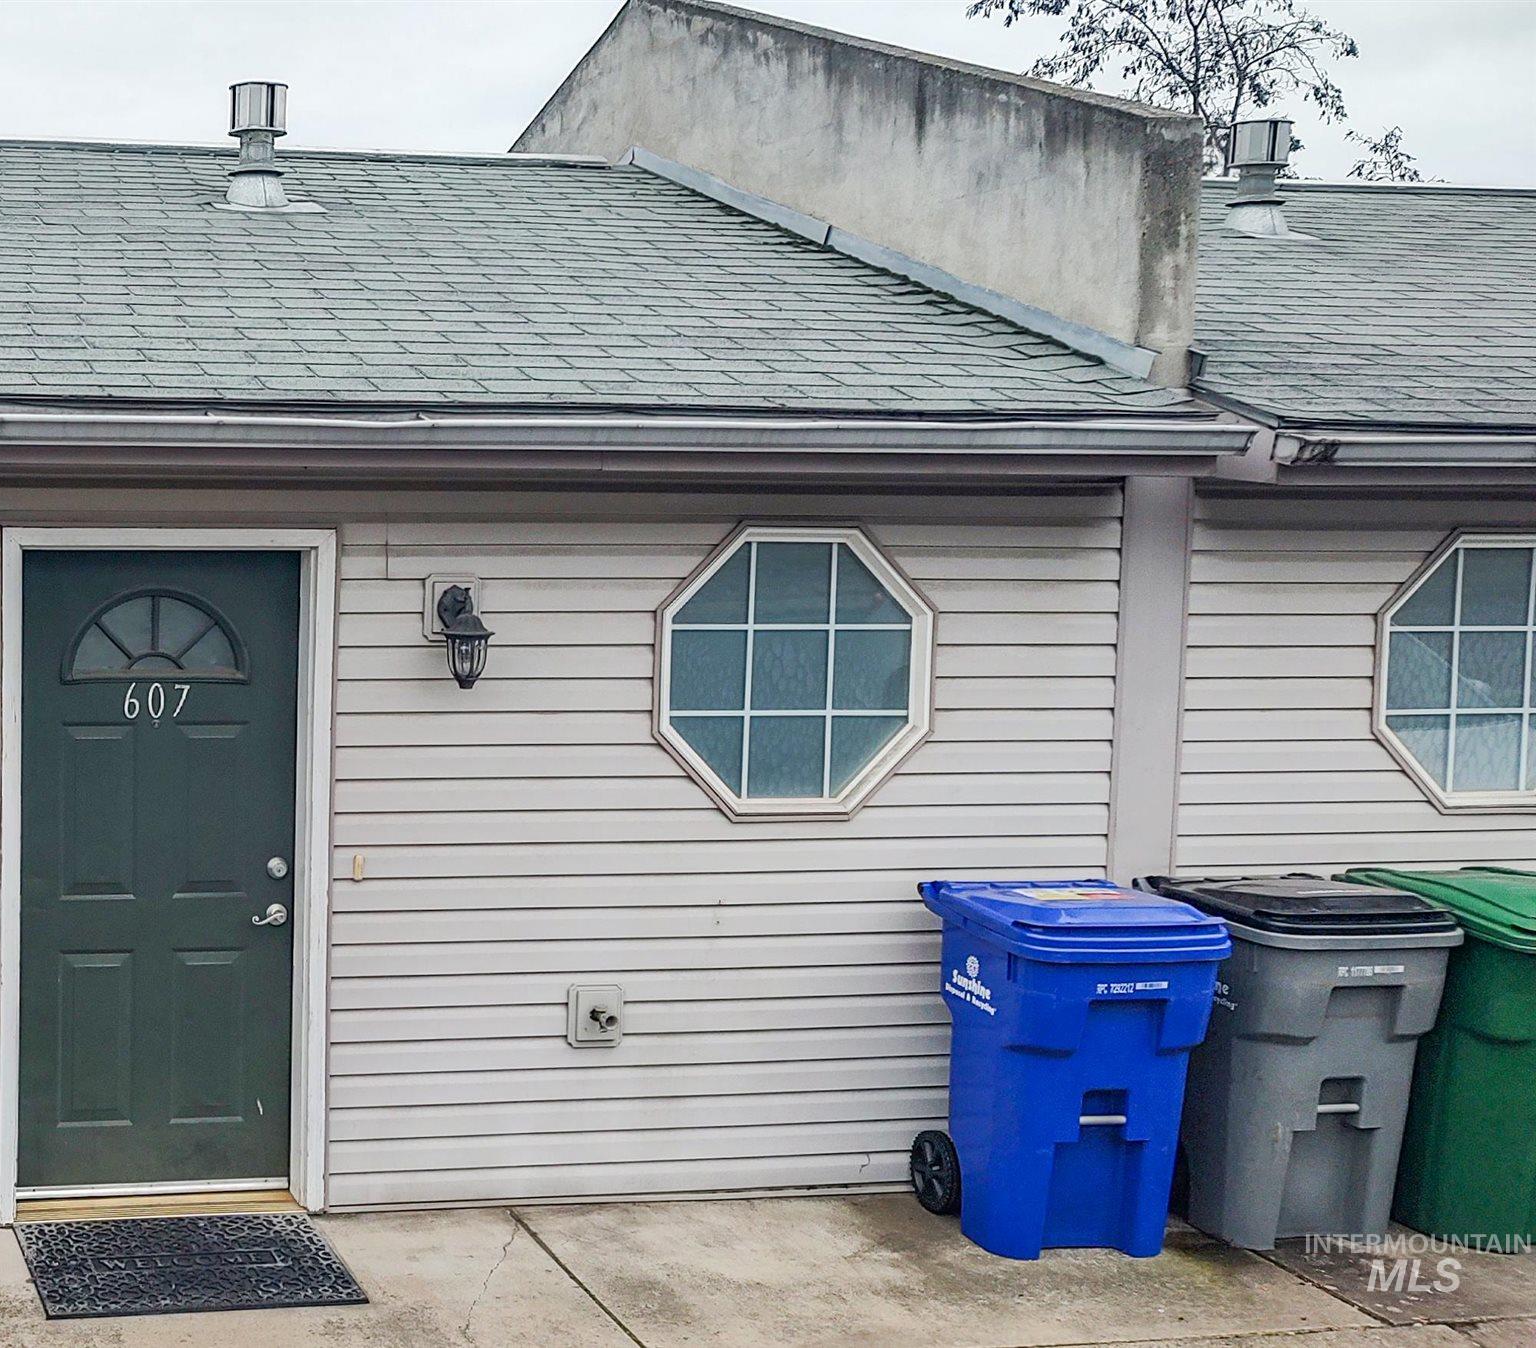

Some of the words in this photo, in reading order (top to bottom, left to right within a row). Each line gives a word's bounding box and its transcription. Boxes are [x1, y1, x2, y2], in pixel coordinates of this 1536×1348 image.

[124, 682, 191, 719] 607
[952, 969, 991, 1000] Sunshine
[99, 1252, 263, 1270] WELCOME
